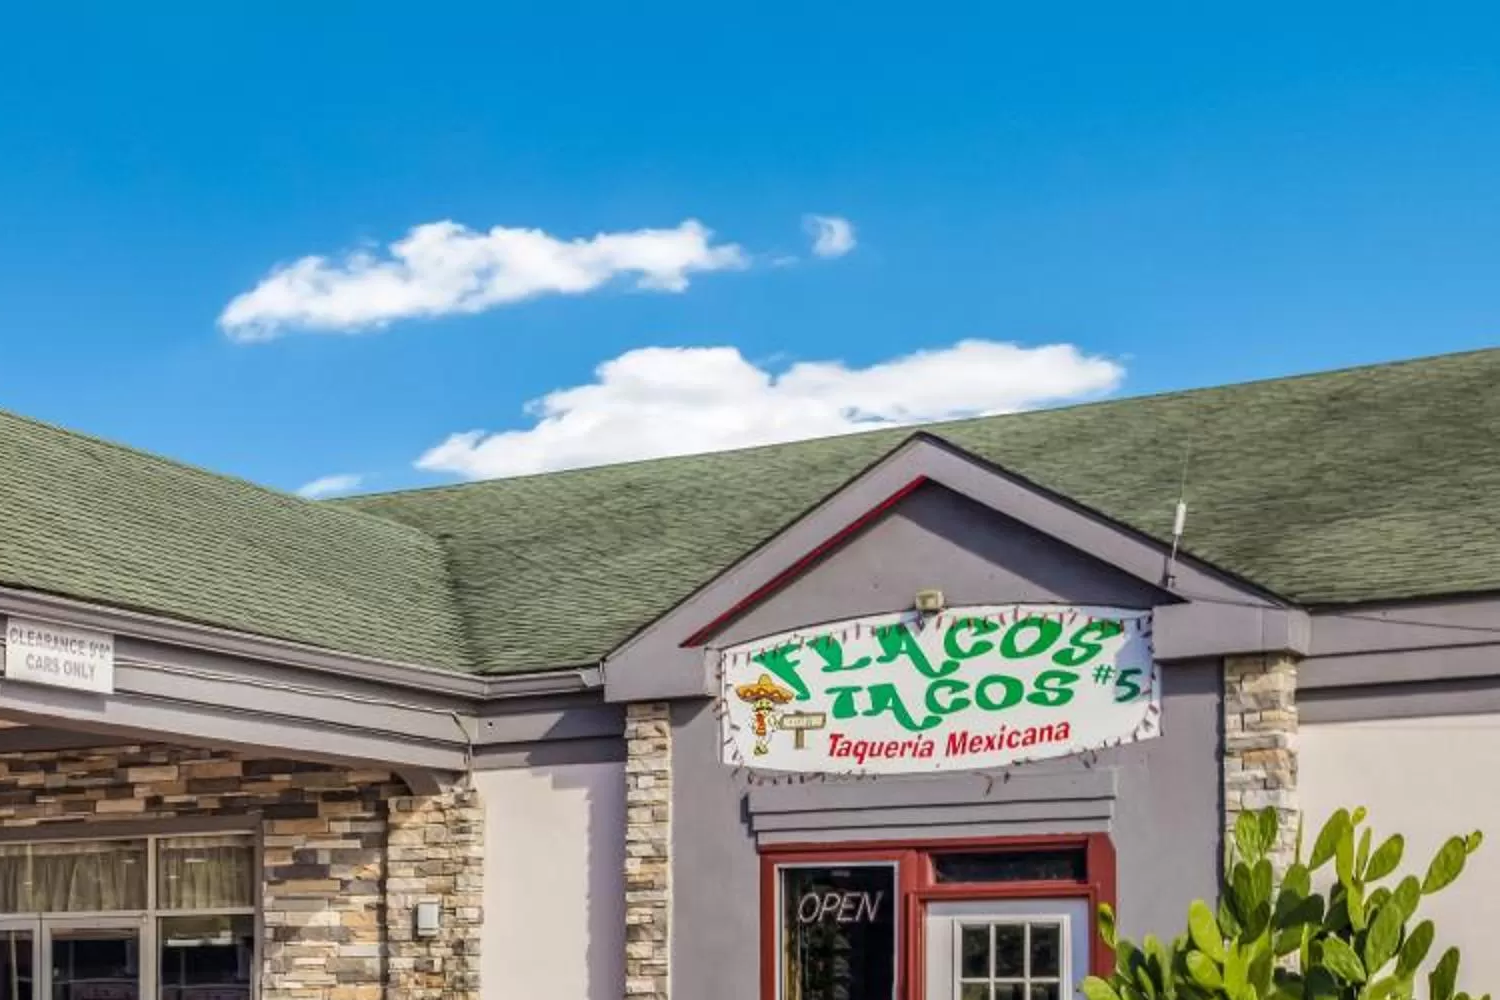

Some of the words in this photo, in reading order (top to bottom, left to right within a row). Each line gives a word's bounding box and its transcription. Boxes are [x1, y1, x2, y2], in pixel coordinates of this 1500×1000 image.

[9, 627, 86, 656] CLEARANCE
[753, 616, 1124, 700] FLACOS
[25, 652, 60, 676] CARS
[63, 659, 97, 682] ONLY
[825, 669, 1079, 732] TACOS
[1092, 663, 1143, 702] #5
[946, 720, 1070, 757] Mexicana
[798, 889, 884, 923] OPEN
